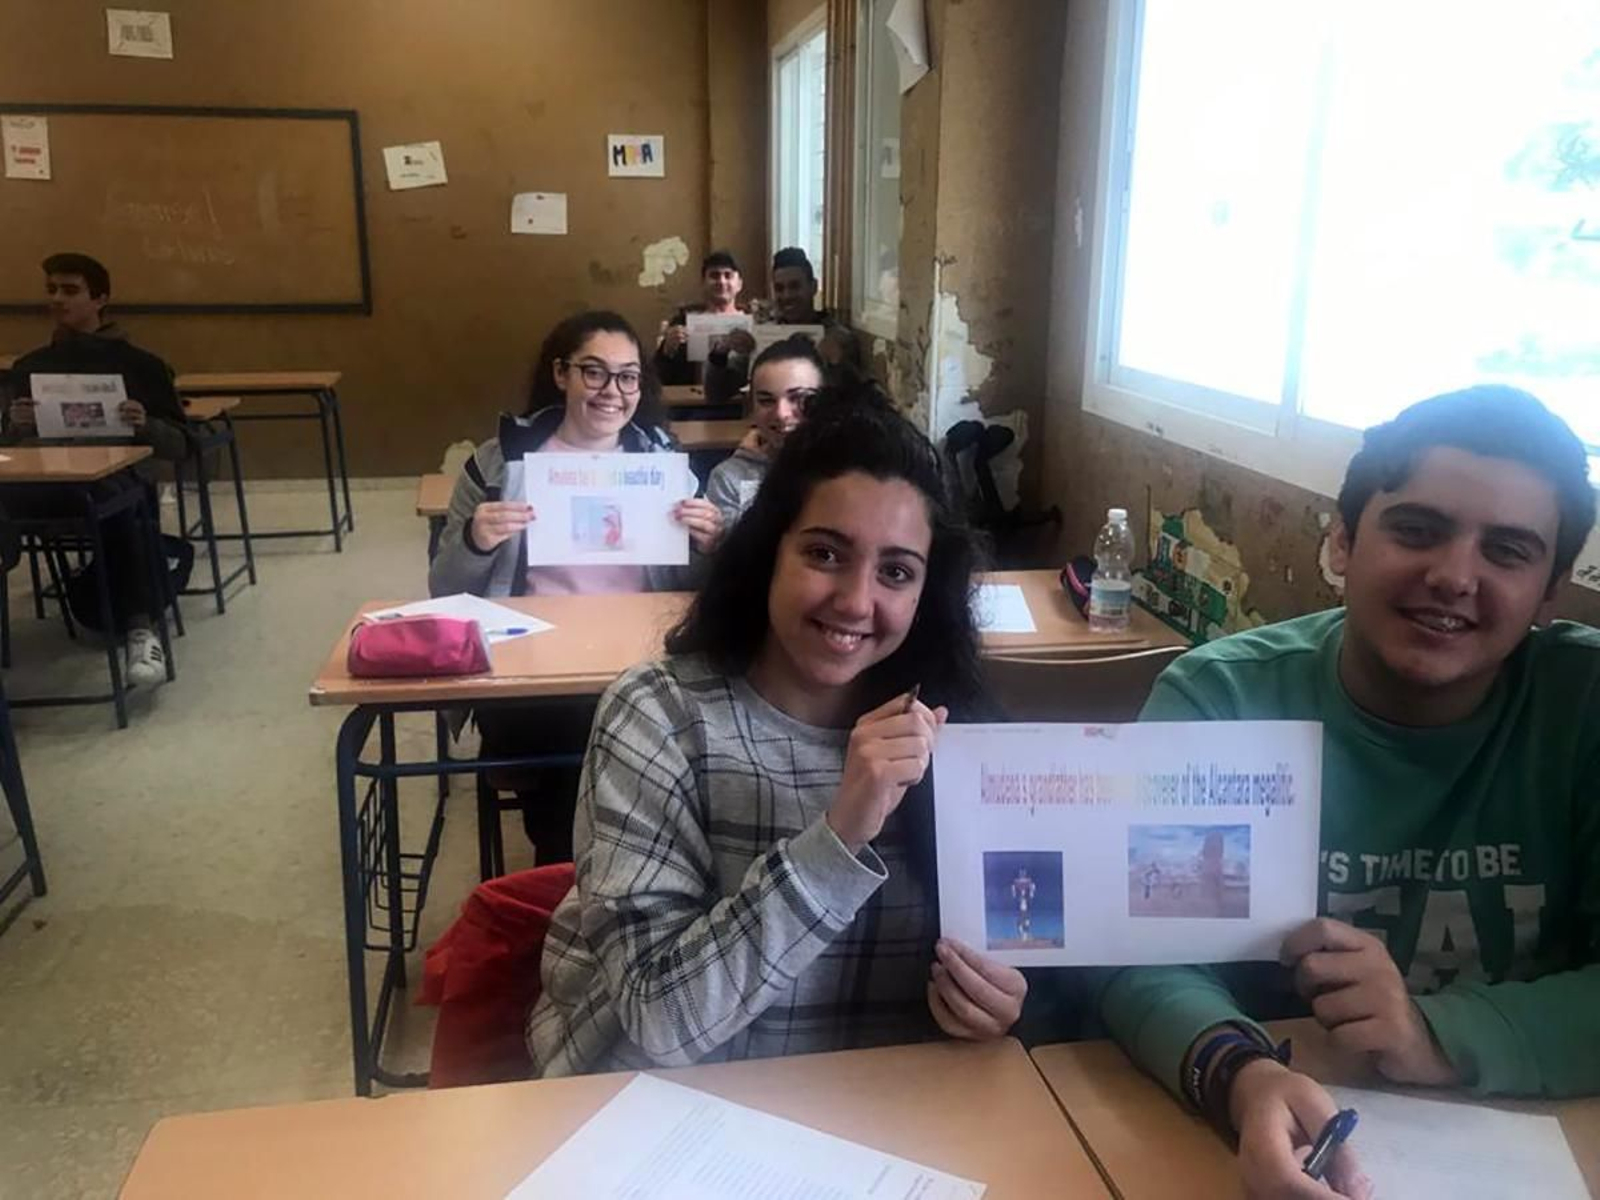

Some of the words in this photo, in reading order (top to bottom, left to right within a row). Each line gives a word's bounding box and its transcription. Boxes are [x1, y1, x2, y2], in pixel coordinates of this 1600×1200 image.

[1321, 850, 1350, 883] 'S
[1360, 849, 1434, 886] TIME
[1475, 844, 1522, 879] BE
